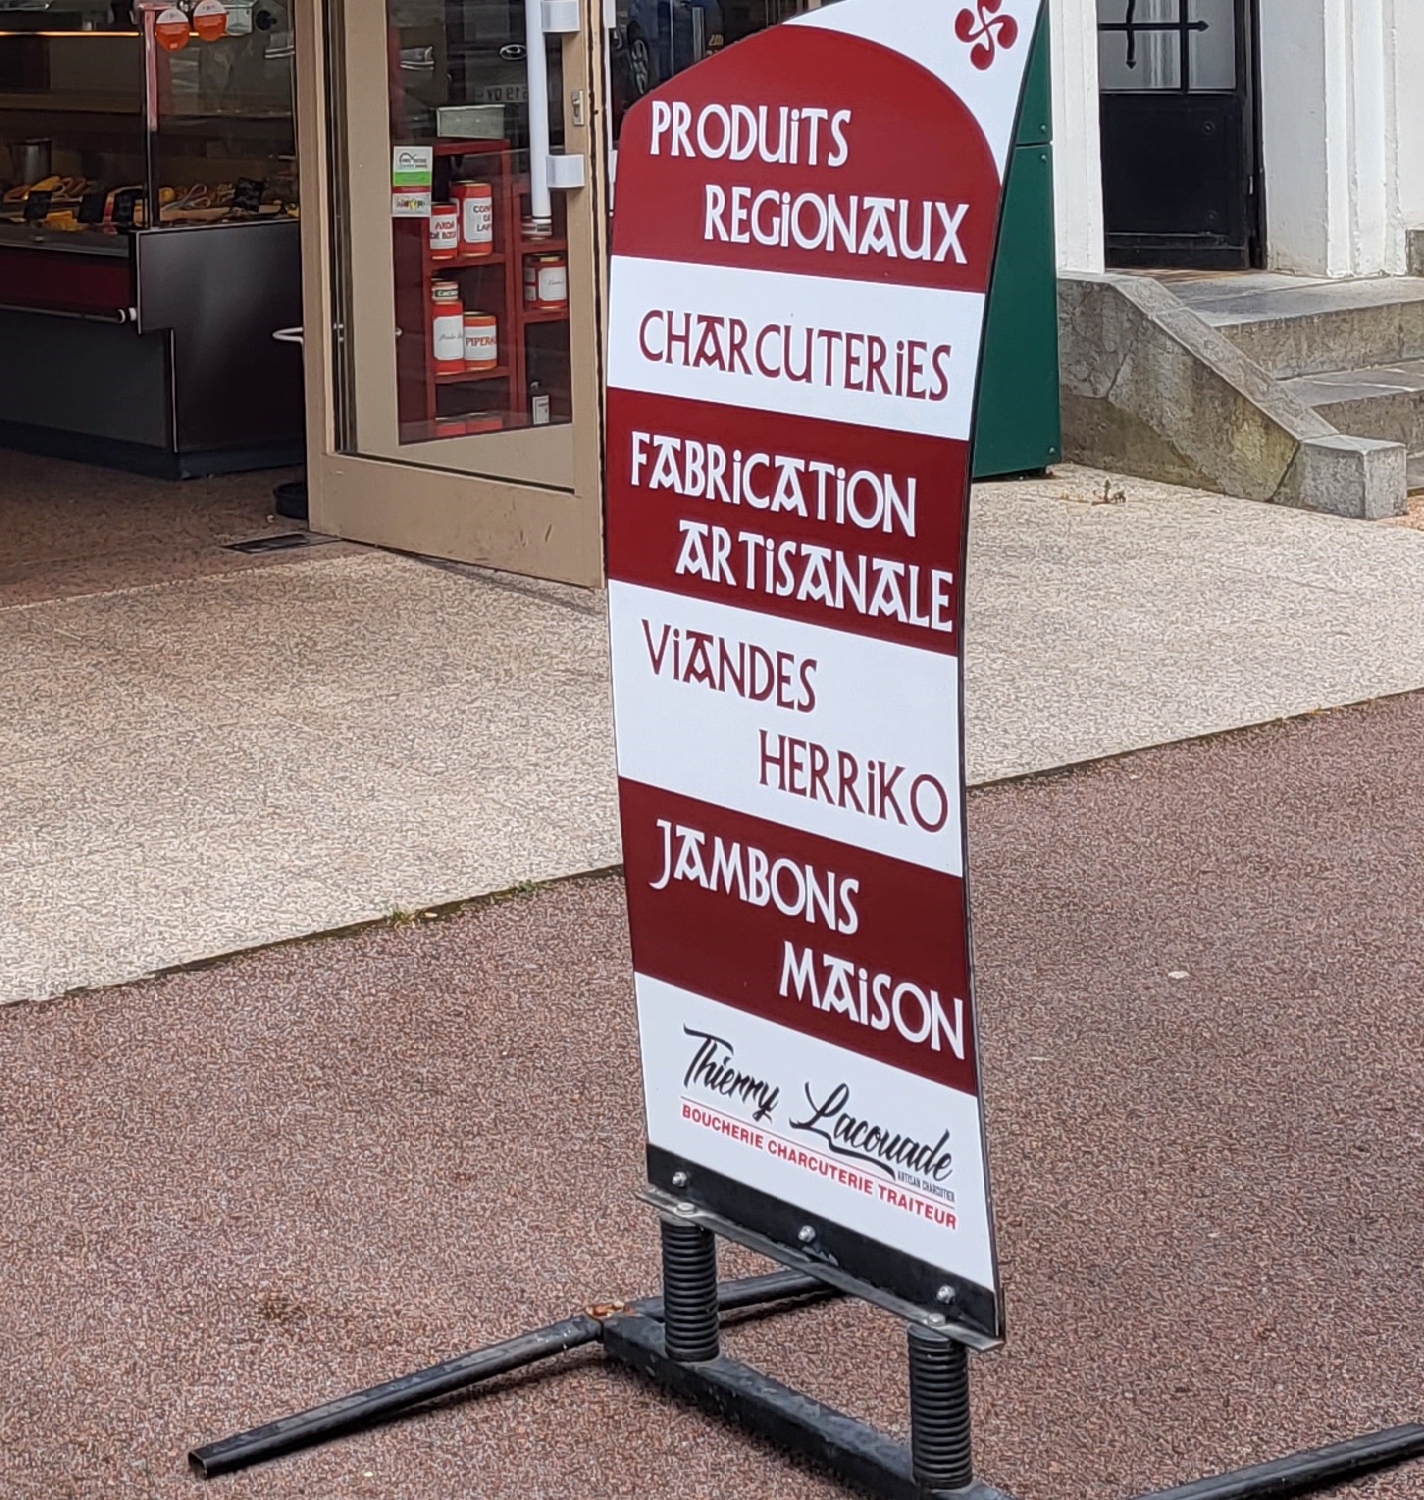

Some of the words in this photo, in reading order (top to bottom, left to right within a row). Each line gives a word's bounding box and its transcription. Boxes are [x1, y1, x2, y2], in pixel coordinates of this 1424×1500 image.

[649, 818, 860, 935] JAMBONS
[683, 1022, 780, 1124] Thierry
[681, 1102, 764, 1150] BOUCHERIE
[767, 1139, 874, 1196] CHARCUTERIE
[878, 1184, 957, 1231] TRAITEUR
